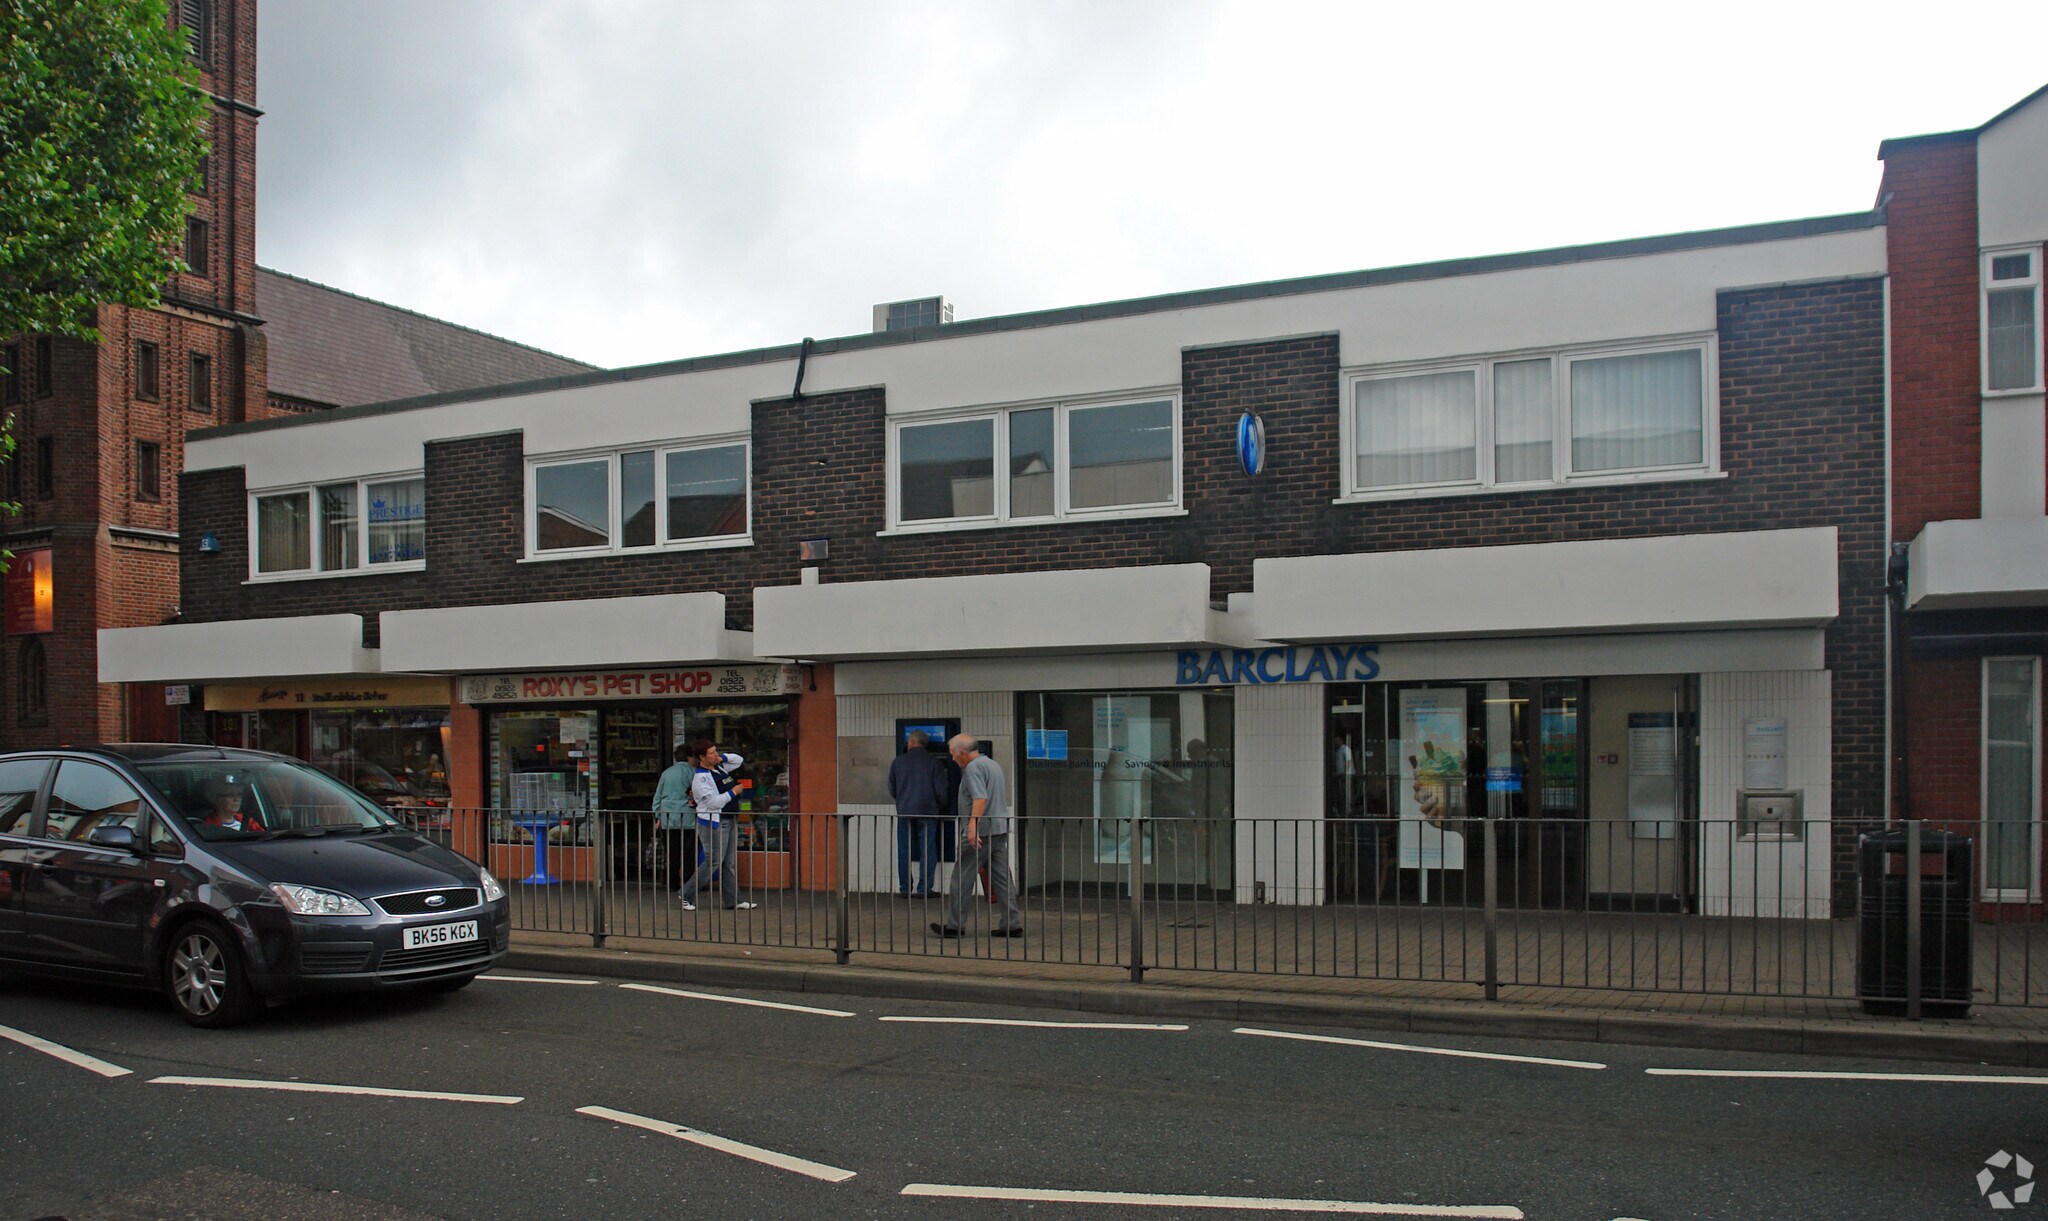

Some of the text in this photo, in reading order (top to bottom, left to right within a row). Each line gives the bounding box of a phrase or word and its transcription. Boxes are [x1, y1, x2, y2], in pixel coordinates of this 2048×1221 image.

[369, 503, 423, 518] PRESTIGE
[1176, 645, 1380, 685] BARCLAYS
[494, 684, 516, 692] 01922
[522, 671, 713, 698] ROXY'S PET SHOP
[717, 685, 746, 693] 492521
[492, 691, 518, 699] 492521
[1069, 759, 1106, 771] banking
[1125, 759, 1161, 770] Savings
[412, 923, 475, 945] BK56 KGX
